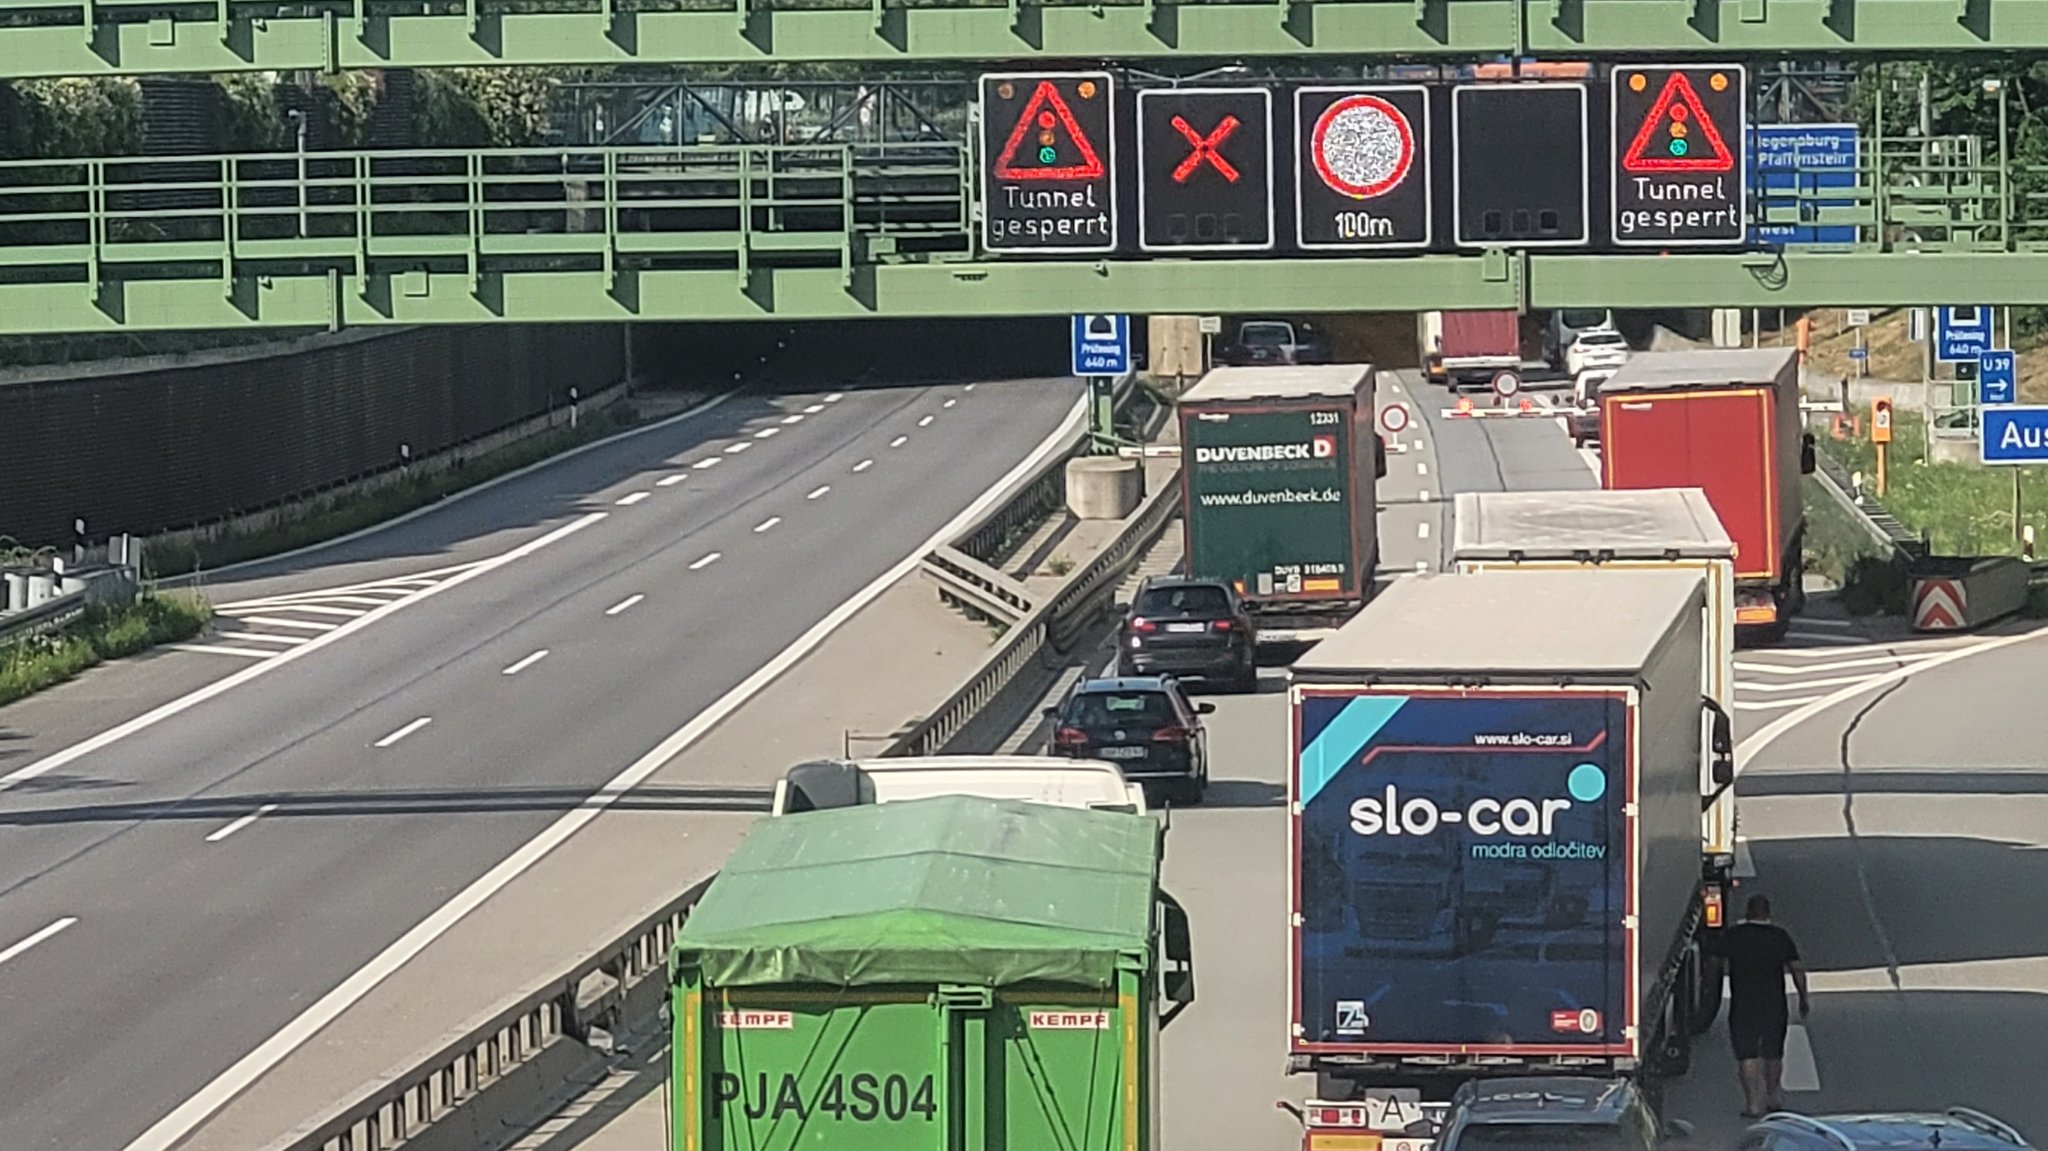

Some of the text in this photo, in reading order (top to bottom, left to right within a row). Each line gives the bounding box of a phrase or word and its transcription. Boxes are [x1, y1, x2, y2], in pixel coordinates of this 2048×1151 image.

[1003, 187, 1096, 208] Tunnel
[1633, 177, 1725, 201] Tunnel
[991, 213, 1110, 244] gesperrt
[1334, 212, 1394, 239] 100m
[1621, 204, 1738, 233] gesperrt
[1085, 357, 1118, 368] 640 m
[1983, 358, 2010, 371] U 39
[1196, 439, 1331, 462] DUVENBECK D
[1200, 487, 1342, 506] www.duvenbeck.de
[1474, 731, 1573, 746] www.slo-car.si
[1350, 784, 1571, 835] slo-car
[1472, 841, 1606, 860] modra odločitev
[719, 1014, 789, 1026] KEMPF
[1033, 1013, 1107, 1027] KEMPF
[711, 1072, 937, 1122] PJA 4S04
[1381, 1095, 1405, 1122] A
